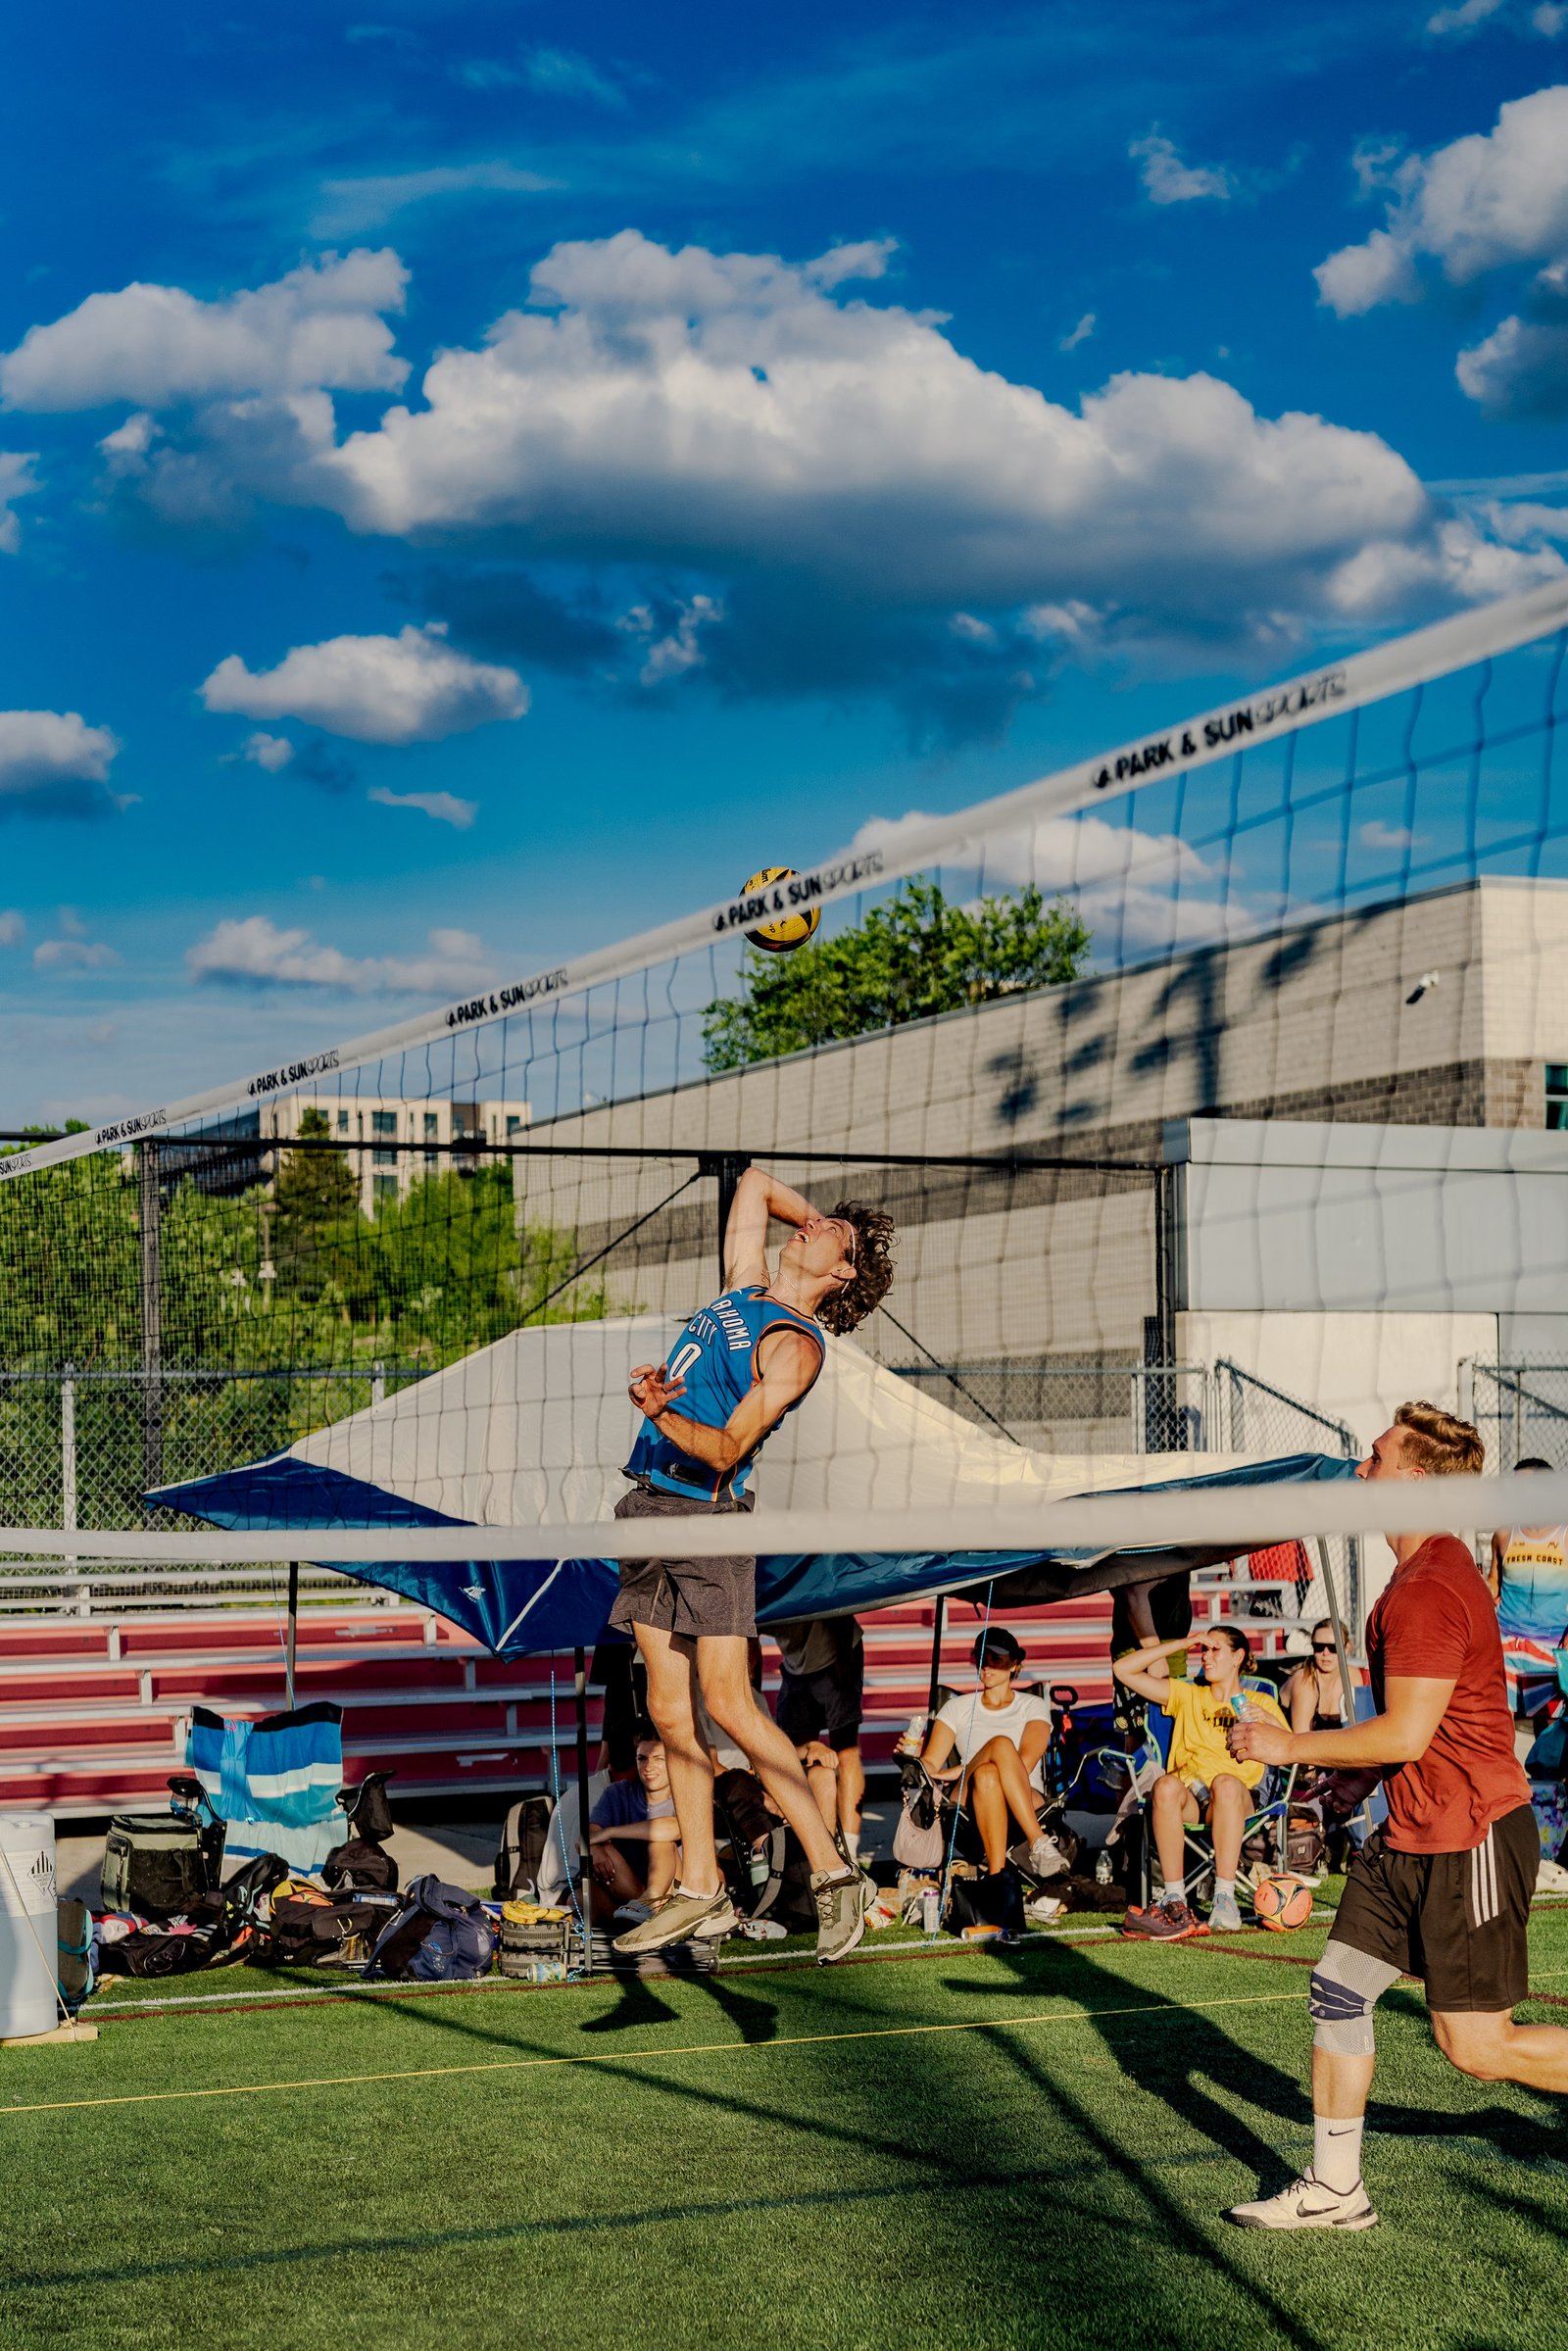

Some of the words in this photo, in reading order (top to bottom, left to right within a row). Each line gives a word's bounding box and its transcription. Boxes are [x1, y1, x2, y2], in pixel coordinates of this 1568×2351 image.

[1115, 739, 1174, 781] PARK
[1180, 731, 1197, 757] &
[728, 895, 770, 927] PARK
[773, 889, 785, 912] &
[457, 998, 488, 1025] PARK
[489, 994, 499, 1015] &
[257, 1071, 279, 1095] PARK
[280, 1068, 288, 1086] &
[101, 1124, 121, 1144] PARK
[688, 1312, 719, 1347] CITY
[708, 1298, 754, 1351] AHOMA
[669, 1342, 703, 1382] 0
[1536, 1554, 1563, 1566] COAST
